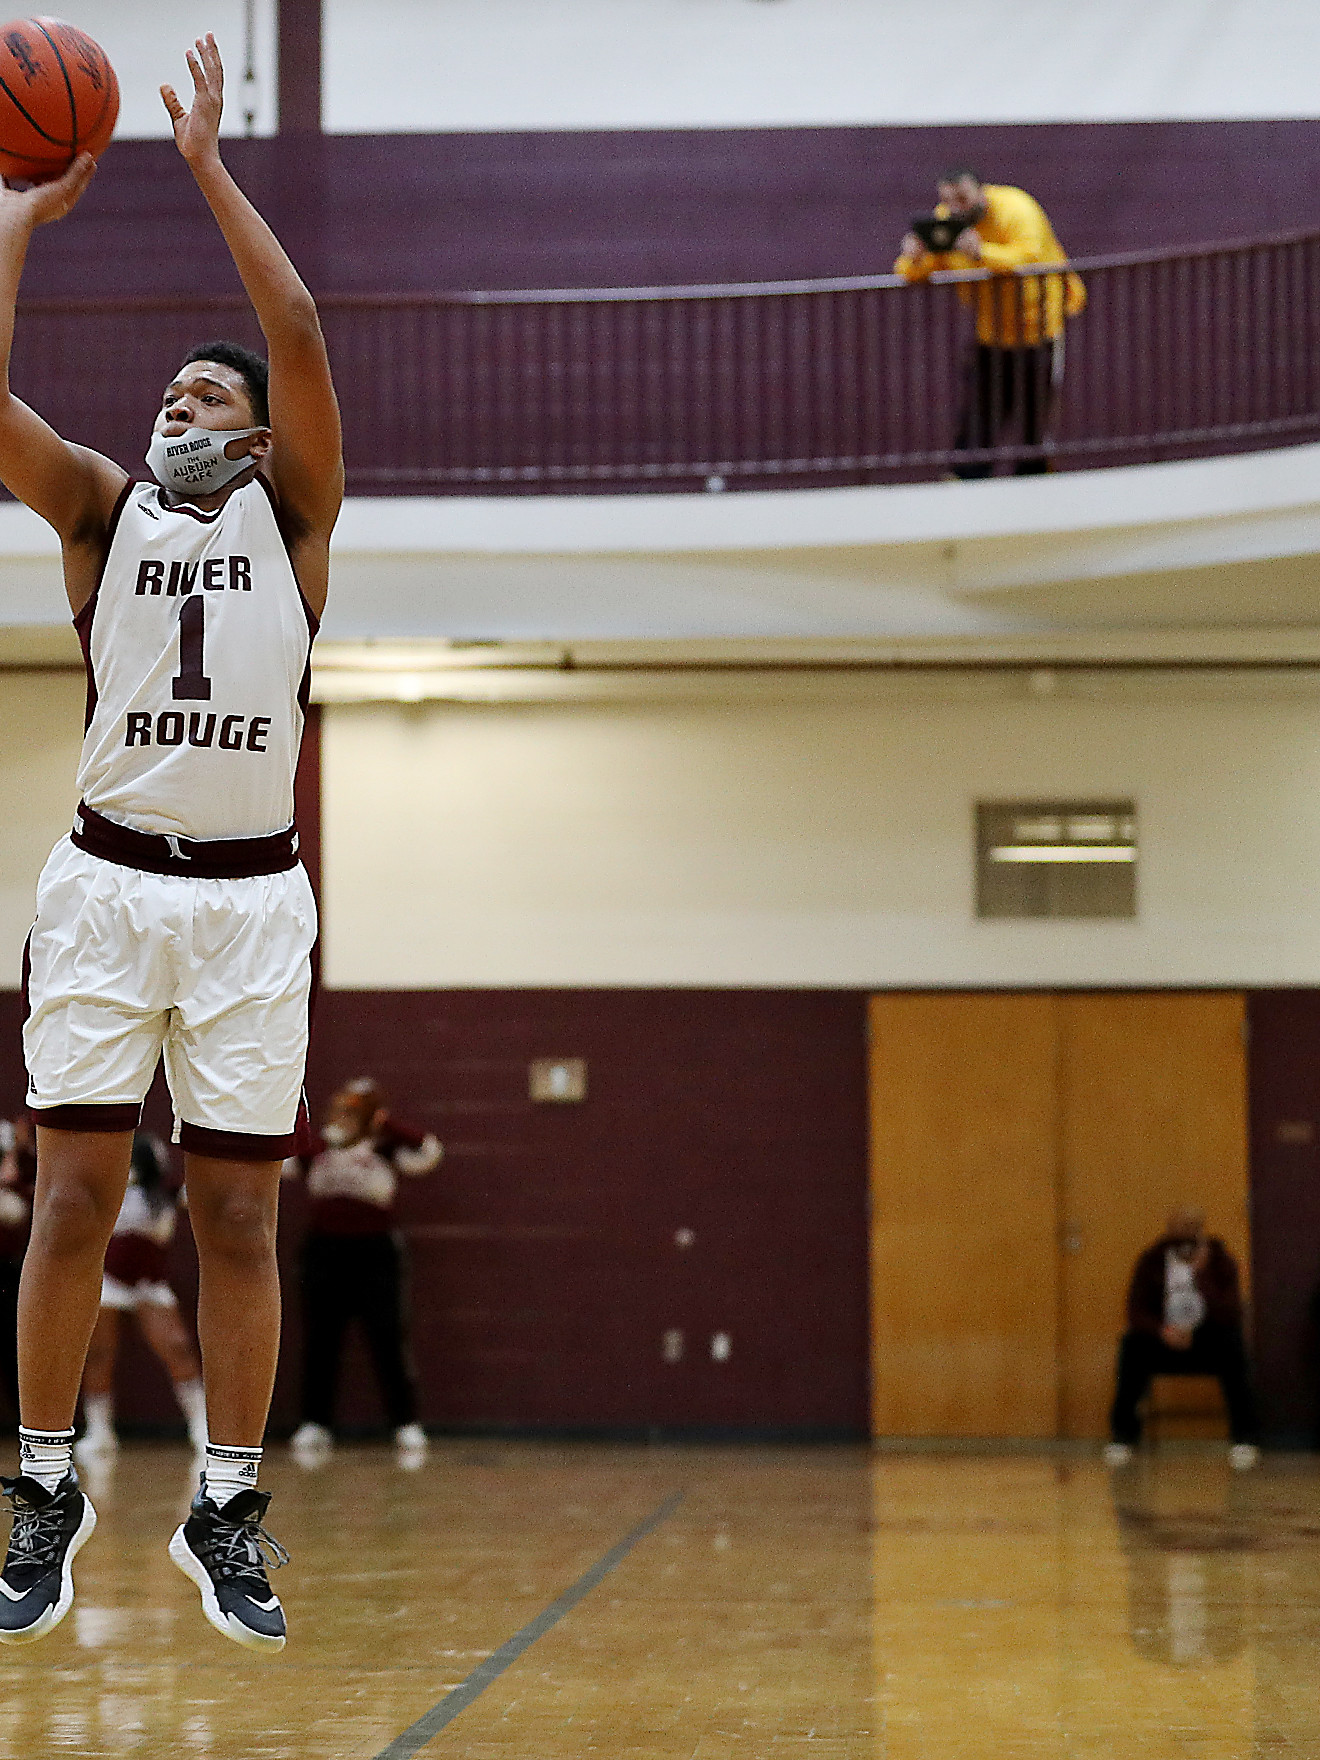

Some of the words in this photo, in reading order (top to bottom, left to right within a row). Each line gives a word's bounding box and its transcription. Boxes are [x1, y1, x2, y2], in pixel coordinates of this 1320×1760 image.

[166, 443, 189, 457] RIVER
[189, 437, 212, 451] ROUGE
[173, 457, 218, 478] AUBURN
[187, 455, 200, 463] THE
[184, 470, 213, 482] CAFE
[135, 555, 252, 597] RIVER
[172, 594, 212, 701] 1
[124, 711, 272, 752] ROUGE
